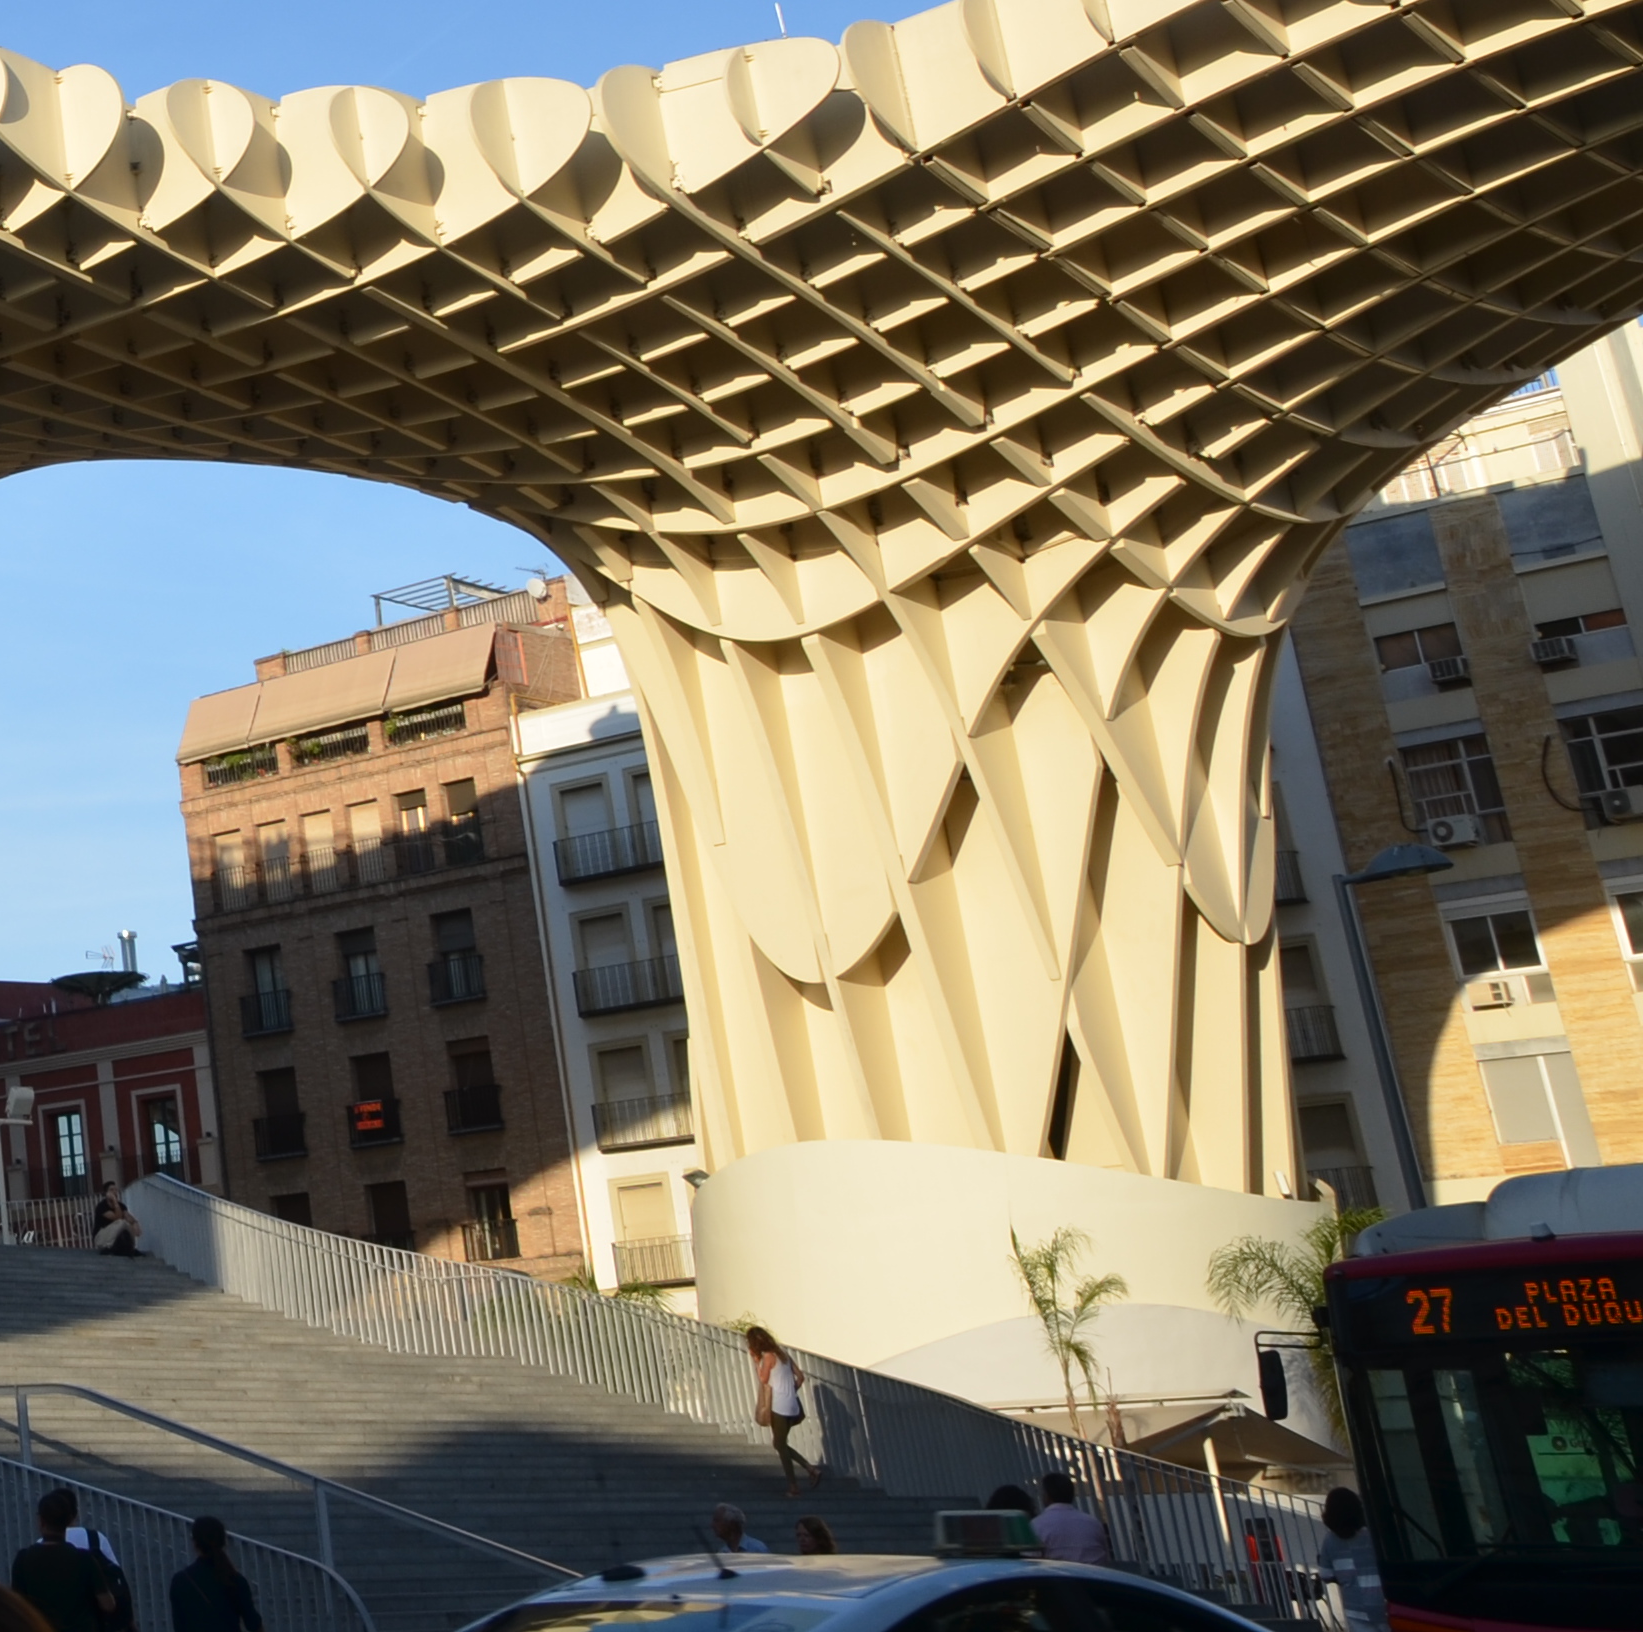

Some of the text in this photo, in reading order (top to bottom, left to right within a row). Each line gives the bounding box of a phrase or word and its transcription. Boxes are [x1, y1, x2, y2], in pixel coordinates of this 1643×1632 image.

[1522, 1276, 1618, 1305] PLAZA
[1405, 1286, 1454, 1336] 27
[1494, 1306, 1550, 1332] DEL
